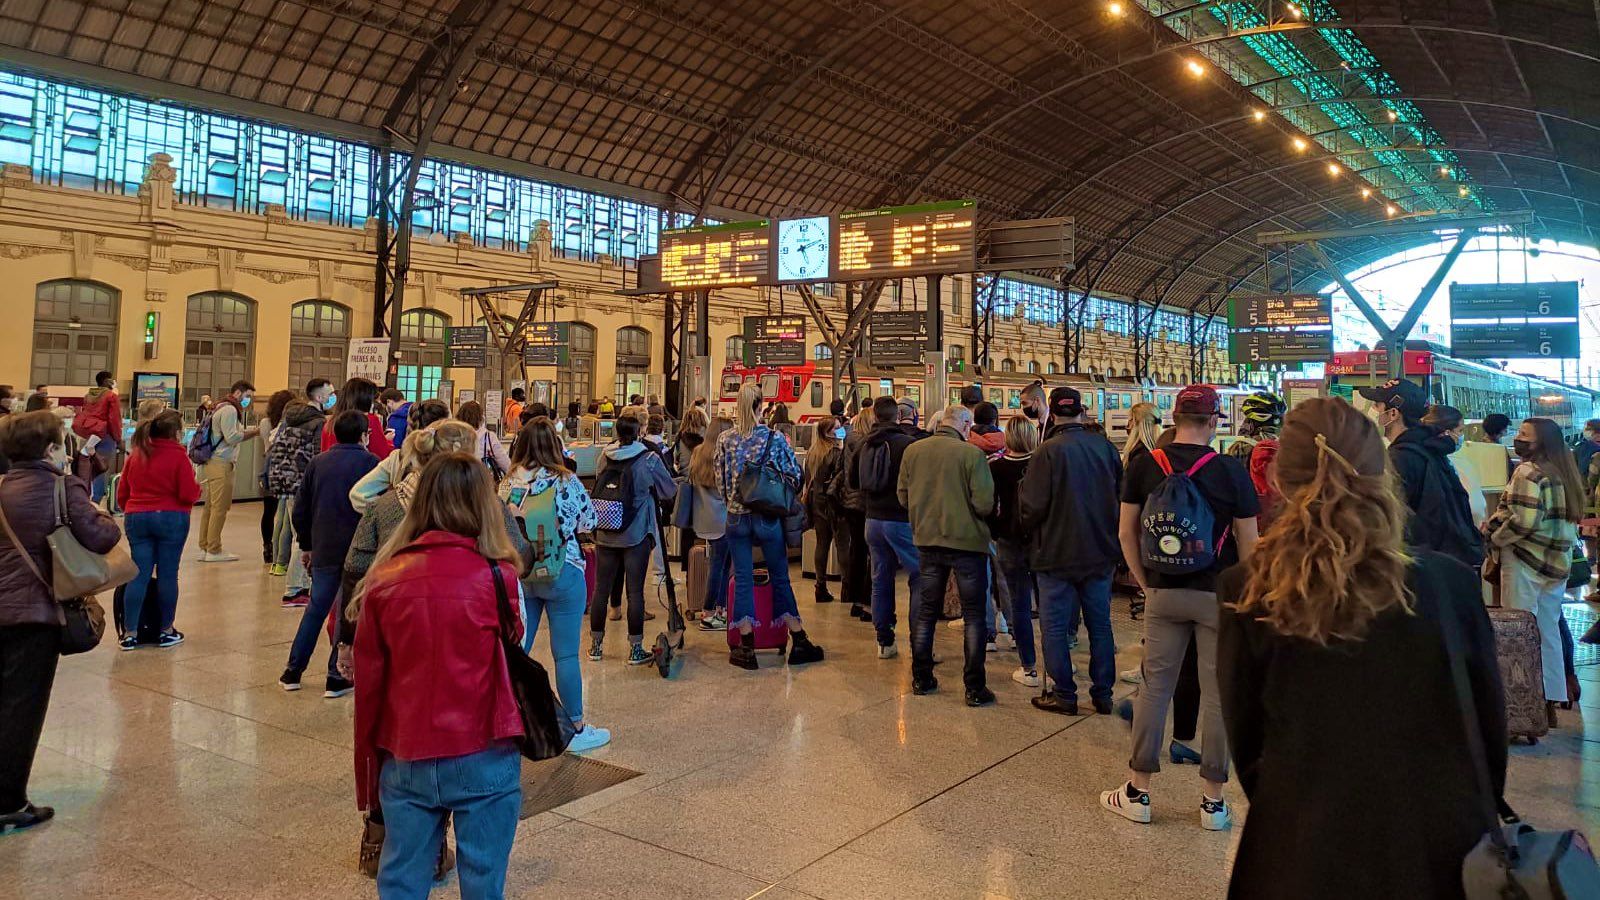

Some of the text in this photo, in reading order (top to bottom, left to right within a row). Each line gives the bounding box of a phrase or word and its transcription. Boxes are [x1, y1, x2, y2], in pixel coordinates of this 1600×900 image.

[799, 224, 809, 233] 12
[782, 246, 789, 254] 9
[818, 243, 825, 252] 3
[799, 266, 806, 274] 6
[1538, 301, 1551, 315] 6
[1249, 312, 1259, 326] 5
[756, 328, 762, 338] 3
[919, 324, 927, 335] 4
[553, 332, 559, 341] 2
[357, 346, 378, 354] ACCESO
[1539, 341, 1552, 356] 6
[919, 354, 926, 365] 4
[1250, 348, 1260, 361] 5
[755, 355, 762, 365] 3
